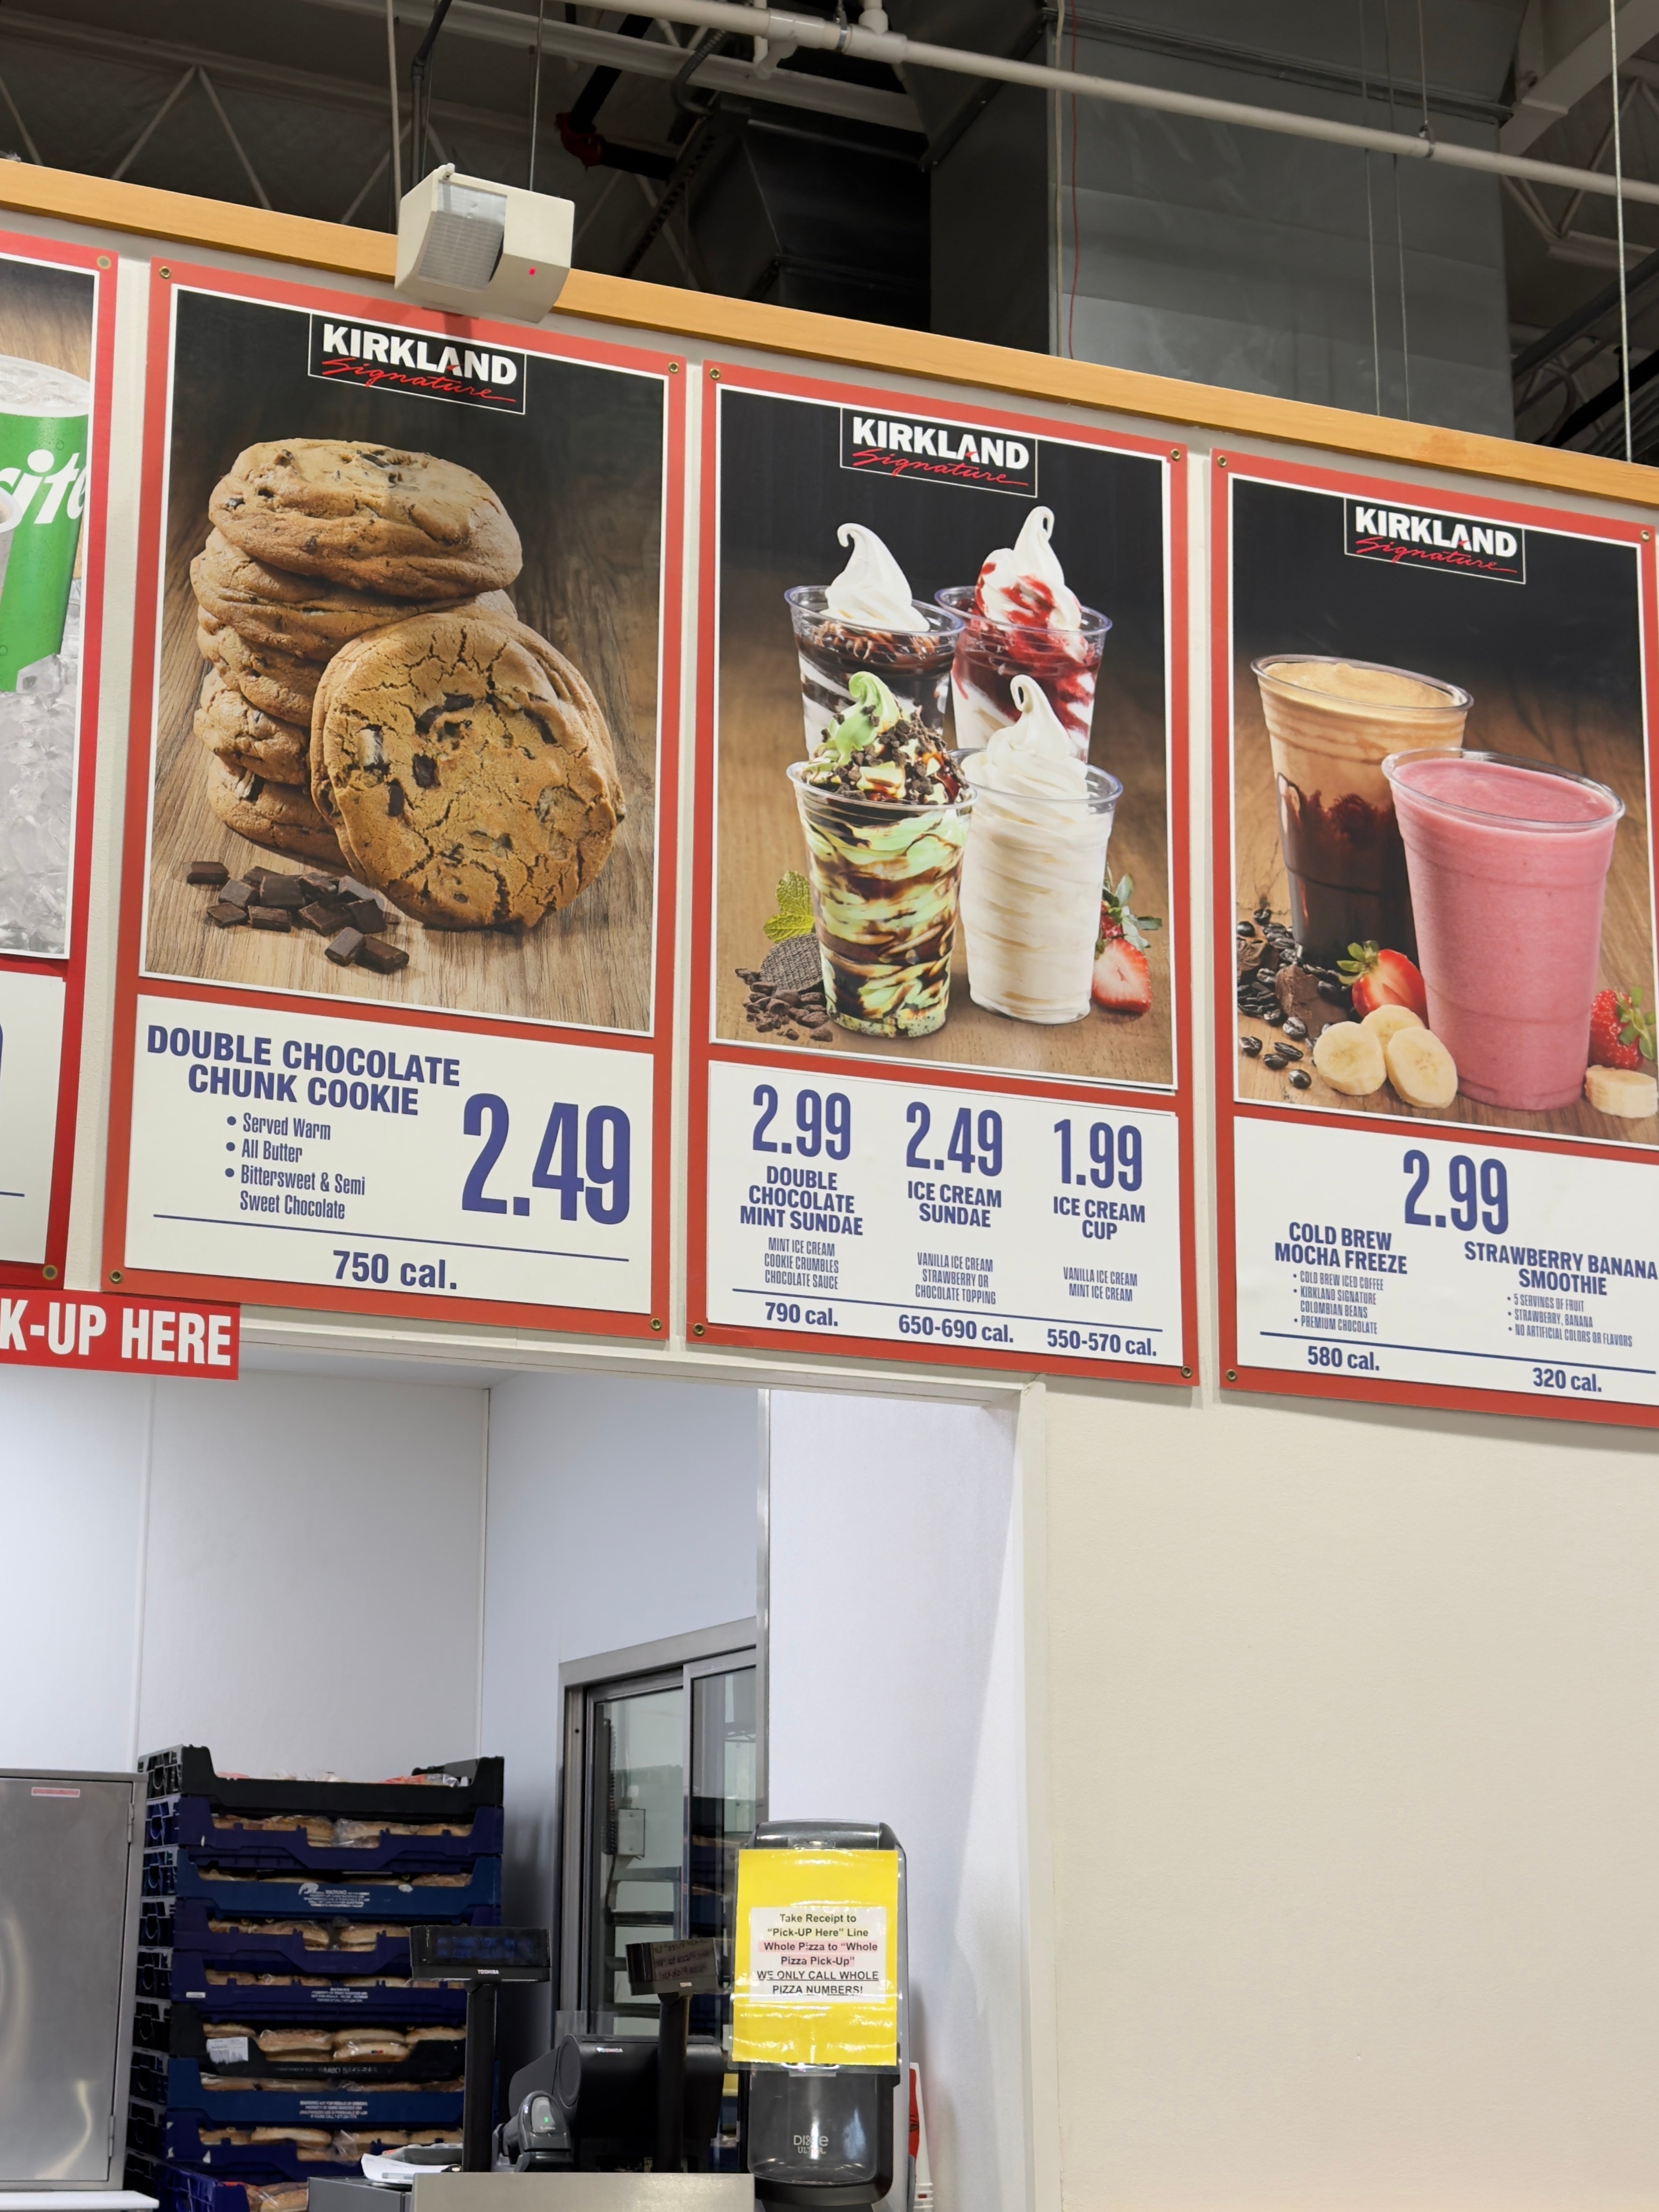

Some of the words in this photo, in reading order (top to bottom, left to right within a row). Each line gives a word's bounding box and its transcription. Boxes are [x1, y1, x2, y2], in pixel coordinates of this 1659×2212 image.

[324, 324, 516, 384] KIRKLAND
[322, 357, 516, 402] Signature
[853, 417, 1029, 469] KIRKLAND
[852, 449, 1028, 485] Signature
[1356, 507, 1516, 557] KIRKLAND
[1355, 536, 1517, 573] Signature
[148, 1025, 271, 1065] DOUBLE
[282, 1041, 460, 1087] CHOCOLATE
[189, 1064, 297, 1102] CHUNK
[308, 1077, 418, 1115] COOKIE
[243, 1113, 288, 1135] Served
[293, 1118, 330, 1140] Warm
[753, 1085, 851, 1160] 2.99
[242, 1139, 258, 1158] All
[263, 1141, 302, 1163] Butter
[907, 1102, 1002, 1176] 2.49
[462, 1093, 630, 1225] 2.49
[1054, 1119, 1142, 1191] 1.99
[241, 1164, 315, 1190] Bittersweet
[320, 1172, 329, 1192] &
[335, 1174, 365, 1195] Semi
[767, 1166, 837, 1191] DOUBLE
[240, 1190, 280, 1213] Sweet
[285, 1195, 345, 1219] Chocolate
[749, 1185, 854, 1213] CHOCOLATE
[908, 1181, 935, 1201] ICE
[940, 1184, 1001, 1208] CREAM
[1403, 1150, 1508, 1234] 2.99
[741, 1206, 785, 1227] MINT
[790, 1211, 863, 1235] SUNDAE
[920, 1203, 990, 1227] SUNDAE
[1054, 1196, 1080, 1216] ICE
[1085, 1199, 1145, 1222] CREAM
[1082, 1220, 1117, 1240] CUP
[1289, 1222, 1336, 1244] COLD
[1342, 1228, 1391, 1250] BREW
[769, 1237, 790, 1252] MINT
[792, 1240, 804, 1254] ICE
[807, 1241, 835, 1256] CREAM
[1275, 1242, 1340, 1267] MOCHA
[1345, 1250, 1407, 1274] FREEZE
[333, 1250, 388, 1284] 750
[400, 1259, 457, 1290] cal.
[765, 1253, 793, 1269] COOKIE
[796, 1256, 838, 1273] CRUMBLES
[917, 1252, 949, 1268] VANILLA
[951, 1256, 963, 1269] ICE
[965, 1257, 993, 1272] CREAM
[1465, 1242, 1583, 1271] STRAWBERRY
[1588, 1255, 1658, 1279] BANANA
[765, 1270, 810, 1287] CHOCOLATE
[813, 1274, 838, 1290] SAUCE
[922, 1269, 976, 1286] STRAWBERRY
[978, 1274, 988, 1288] OR
[1064, 1267, 1094, 1282] VANILLA
[1097, 1270, 1108, 1284] ICE
[1110, 1271, 1137, 1286] CREAM
[1301, 1270, 1317, 1284] COLD
[1320, 1273, 1340, 1286] BREW
[1342, 1275, 1358, 1288] ICED
[1359, 1277, 1383, 1291] COFFEE
[1519, 1269, 1607, 1295] SMOOTHIE
[915, 1284, 959, 1301] CHOCOLATE
[962, 1289, 995, 1305] TOPPING
[1069, 1283, 1089, 1297] MINT
[1092, 1285, 1103, 1299] ICE
[1106, 1287, 1132, 1301] CREAM
[1301, 1286, 1335, 1300] KIRKLAND
[1337, 1290, 1376, 1305] SIGNATURE
[1514, 1293, 1518, 1305] 5
[1520, 1294, 1554, 1309] SERVINGS
[1556, 1298, 1563, 1309] OF
[1566, 1299, 1584, 1312] FRUIT
[765, 1302, 800, 1323] 790
[806, 1308, 837, 1326] cal.
[1301, 1300, 1343, 1316] COLOMBIAN
[1345, 1305, 1367, 1318] BEANS
[1515, 1309, 1563, 1326] STRAWBERRY,
[1565, 1314, 1593, 1327] BANANA
[121, 1307, 231, 1366] HERE
[899, 1314, 976, 1339] 650-690
[982, 1325, 1013, 1342] cal.
[1301, 1315, 1336, 1330] PREMIUM
[1338, 1319, 1377, 1334] CHOCOLATE
[1516, 1324, 1524, 1336] NO
[1527, 1325, 1562, 1340] ARTIFICIAL
[1565, 1329, 1590, 1342] COLORS
[1593, 1332, 1601, 1343] OR
[1603, 1333, 1632, 1347] FLAVORS
[1048, 1329, 1121, 1353] 550-570
[1126, 1338, 1156, 1356] cal.
[1308, 1346, 1342, 1367] 580
[1347, 1352, 1379, 1370] cal.
[1533, 1368, 1566, 1389] 320
[1571, 1374, 1602, 1392] cal.
[779, 1914, 802, 1922] Take
[806, 1914, 844, 1924] Receipt
[768, 1928, 812, 1936] “Pick-UP
[815, 1928, 844, 1936] Here”
[764, 1942, 795, 1950] Whole
[798, 1942, 824, 1950] Pizza
[781, 1956, 807, 1965] Pizza
[810, 1956, 854, 1967] Pick-Up”
[757, 1971, 773, 1980] WE
[777, 1971, 805, 1979] ONLY
[808, 1971, 836, 1979] CALL
[839, 1971, 879, 1980] WHOLE
[772, 1985, 803, 1994] PIZZA
[807, 1985, 863, 1994] NUMBERS!
